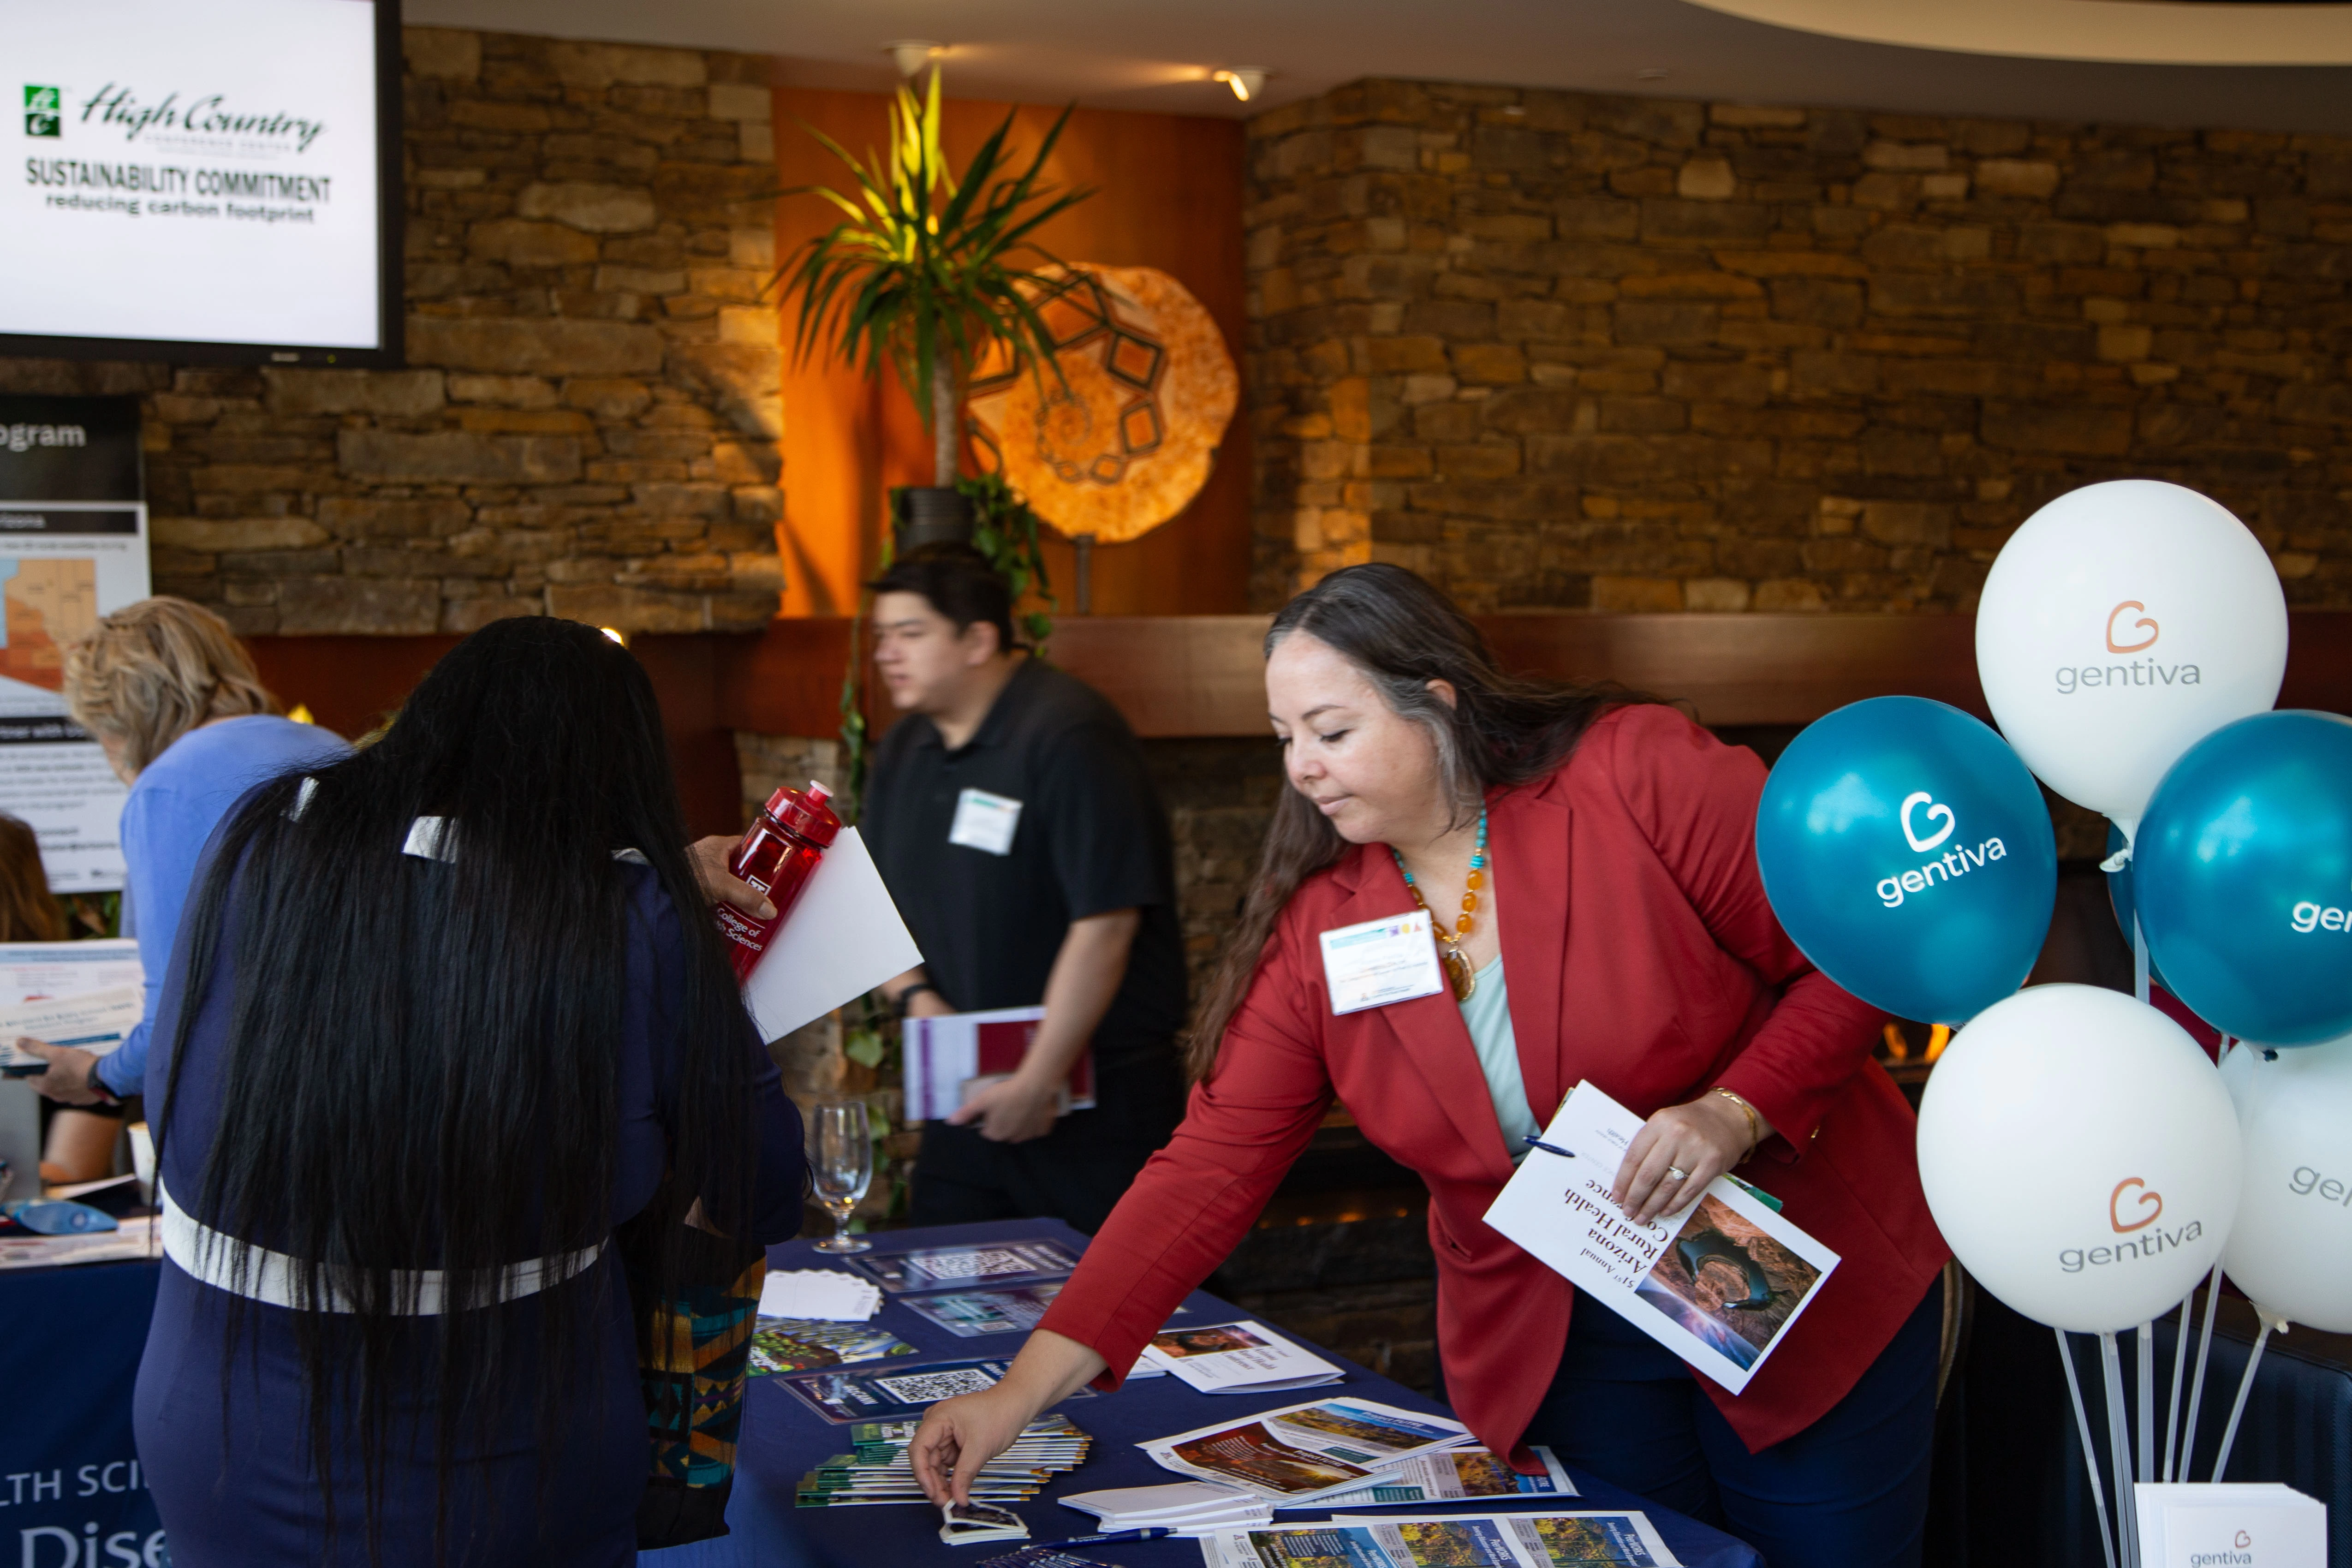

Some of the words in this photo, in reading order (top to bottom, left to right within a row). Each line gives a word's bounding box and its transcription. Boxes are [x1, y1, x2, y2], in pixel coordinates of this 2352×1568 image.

[80, 82, 178, 142] High
[185, 93, 326, 153] Country
[26, 157, 188, 192] SUSTAINABILITY
[195, 170, 332, 203] COMMITMENT
[47, 193, 140, 215] reducing
[148, 198, 219, 218] carbon
[226, 203, 316, 224] footprint
[0, 423, 87, 452] gram
[2055, 658, 2202, 695] gentiva
[1876, 837, 2007, 907] gentiva
[717, 908, 748, 931] College
[748, 929, 761, 937] of
[726, 929, 762, 951] Sciences
[1563, 1187, 1615, 1230] Health
[1579, 1246, 1616, 1274] Annual
[1586, 1228, 1649, 1274] Arizona
[1613, 1223, 1660, 1260] Rural
[2059, 1219, 2202, 1273] gentiva
[1292, 1449, 1322, 1461] Project
[1317, 1457, 1346, 1467] FUTRE
[0, 1468, 61, 1507] TH
[77, 1459, 149, 1497] SCI
[1489, 1538, 1512, 1560] PeerWORKS
[2191, 1551, 2251, 1568] gentiva
